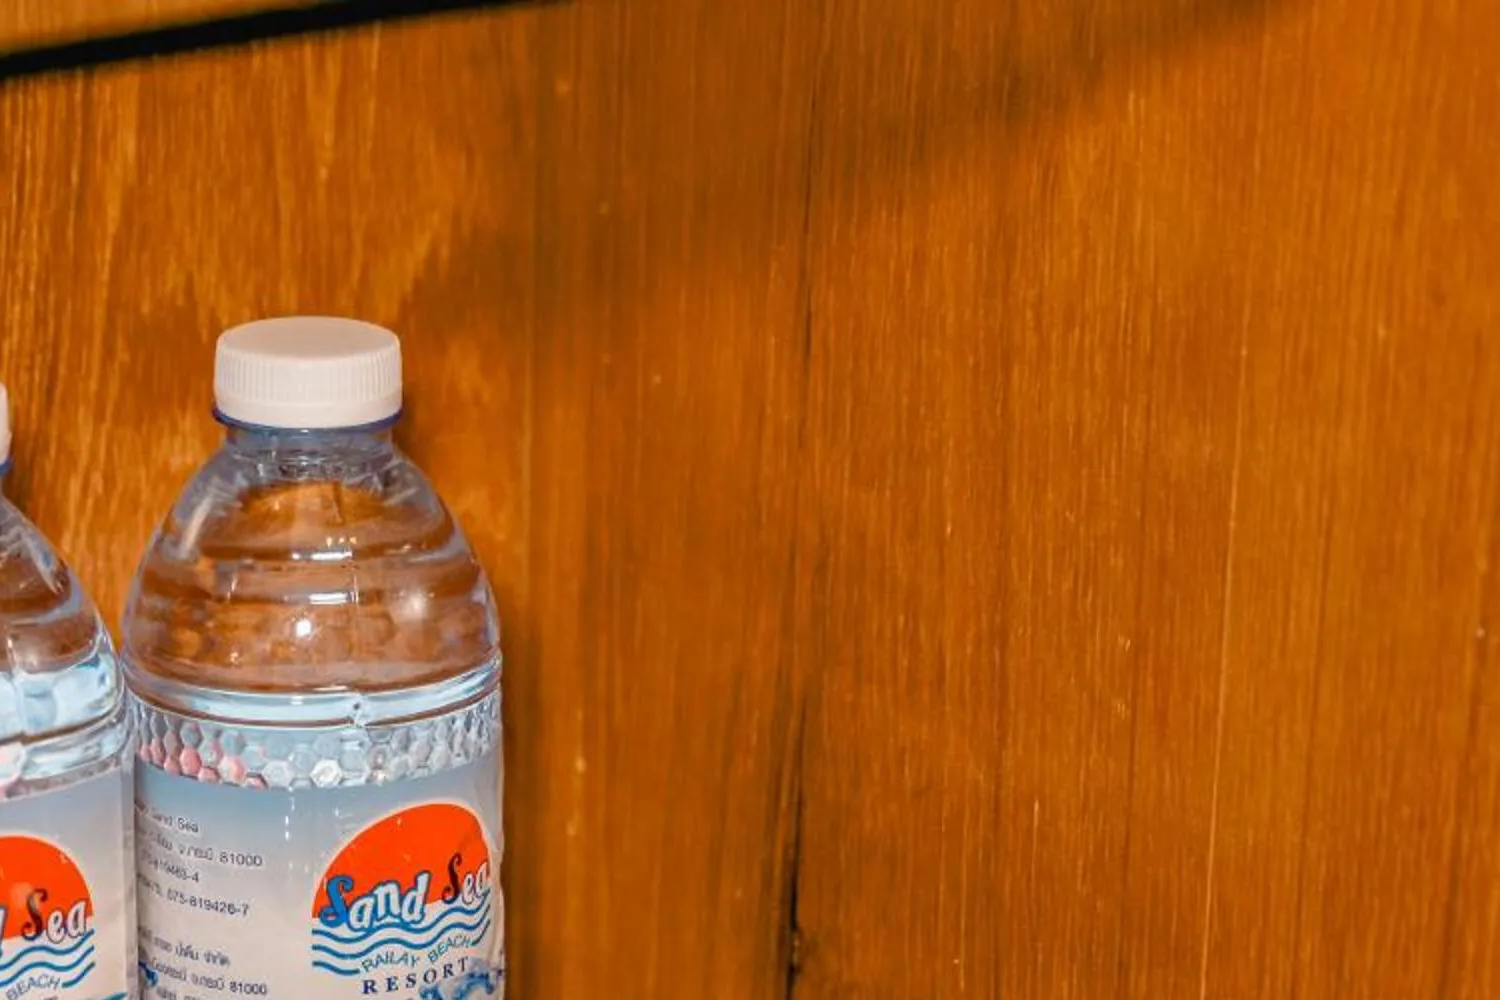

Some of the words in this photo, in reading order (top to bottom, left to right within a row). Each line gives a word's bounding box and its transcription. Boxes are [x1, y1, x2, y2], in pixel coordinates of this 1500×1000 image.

[218, 850, 264, 868] 81000
[320, 869, 432, 932] Sand
[441, 852, 490, 905] Sea
[21, 887, 87, 945] Sea
[361, 950, 421, 974] RAILAY
[426, 933, 473, 964] BEACH
[229, 980, 268, 996] 81000
[361, 955, 470, 996] RESORT
